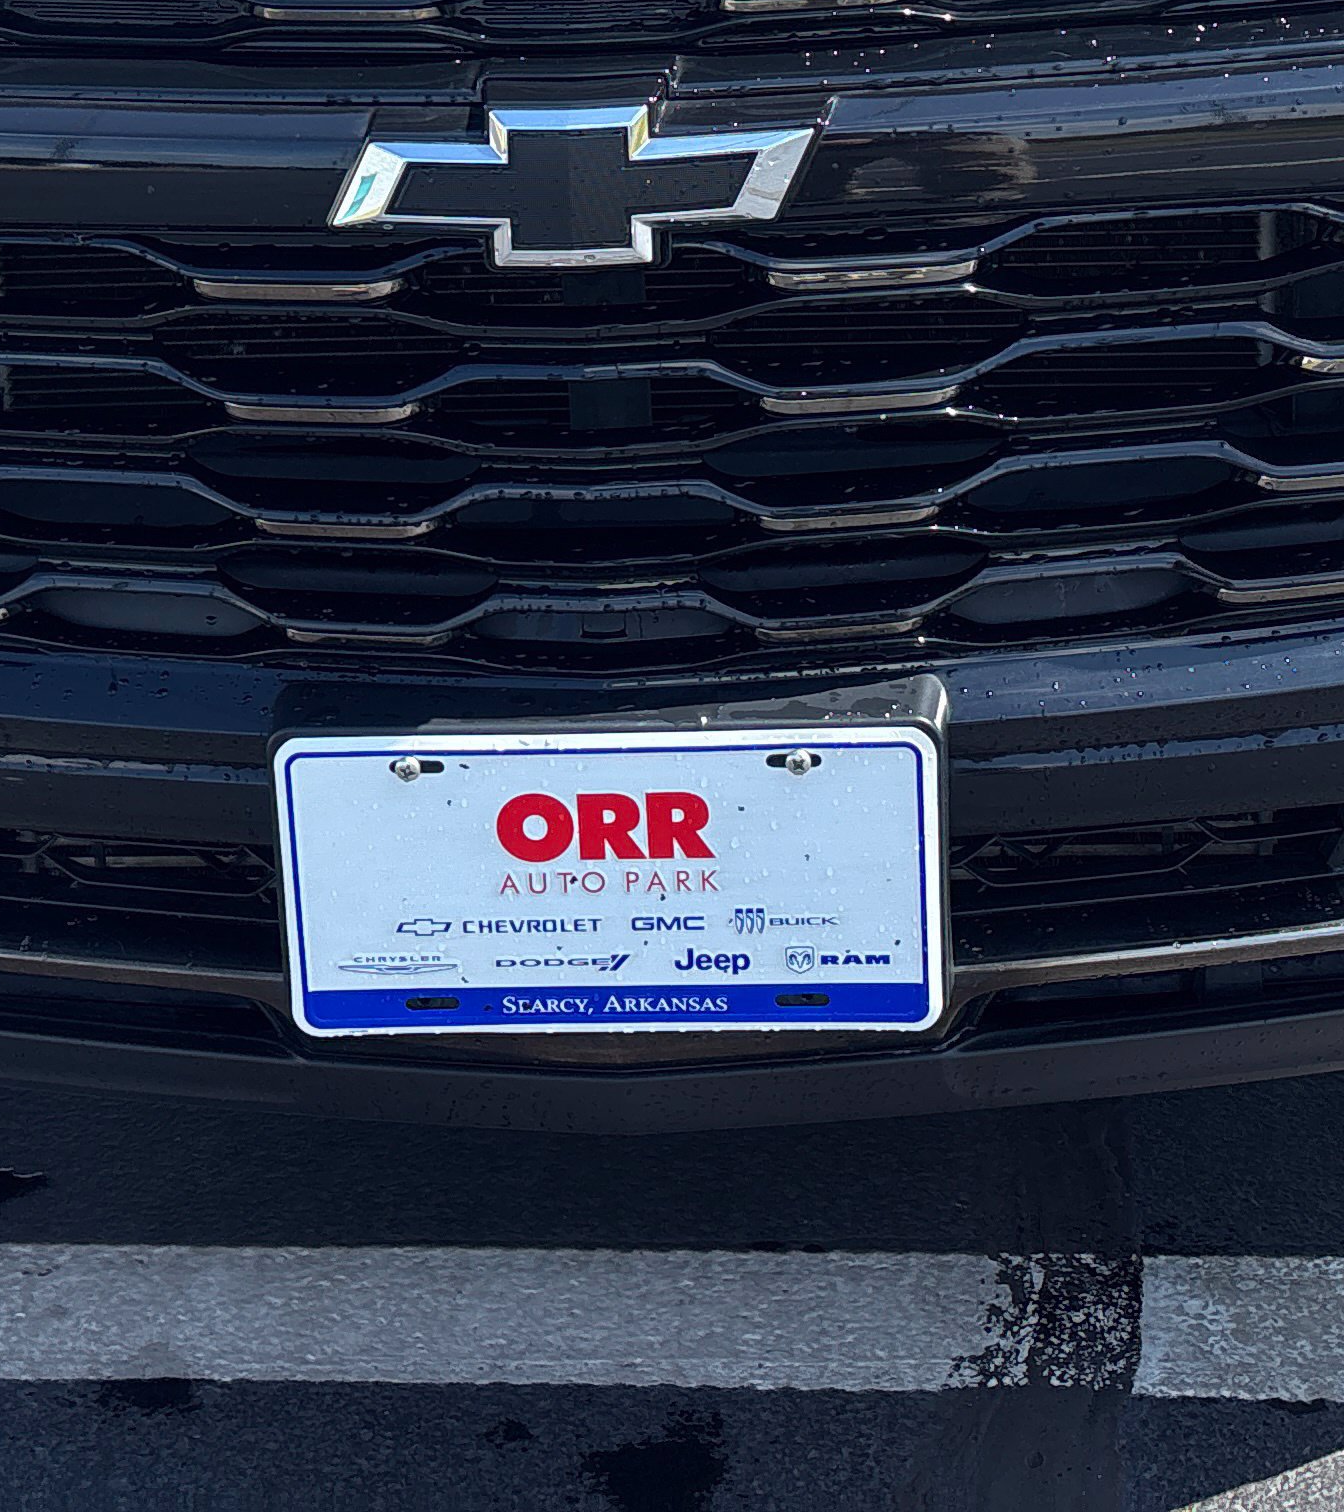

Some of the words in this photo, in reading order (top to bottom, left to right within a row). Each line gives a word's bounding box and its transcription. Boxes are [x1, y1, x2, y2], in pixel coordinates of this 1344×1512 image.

[496, 791, 717, 863] ORR
[499, 871, 606, 895] AUTO
[625, 869, 720, 893] PARK
[462, 918, 602, 934] CHEVROLET
[630, 916, 706, 932] GMC
[768, 915, 839, 927] BUICK
[352, 954, 442, 964] CHRYSLER
[495, 957, 611, 968] DODGE
[674, 947, 751, 975] Jeep
[820, 953, 891, 966] RAM
